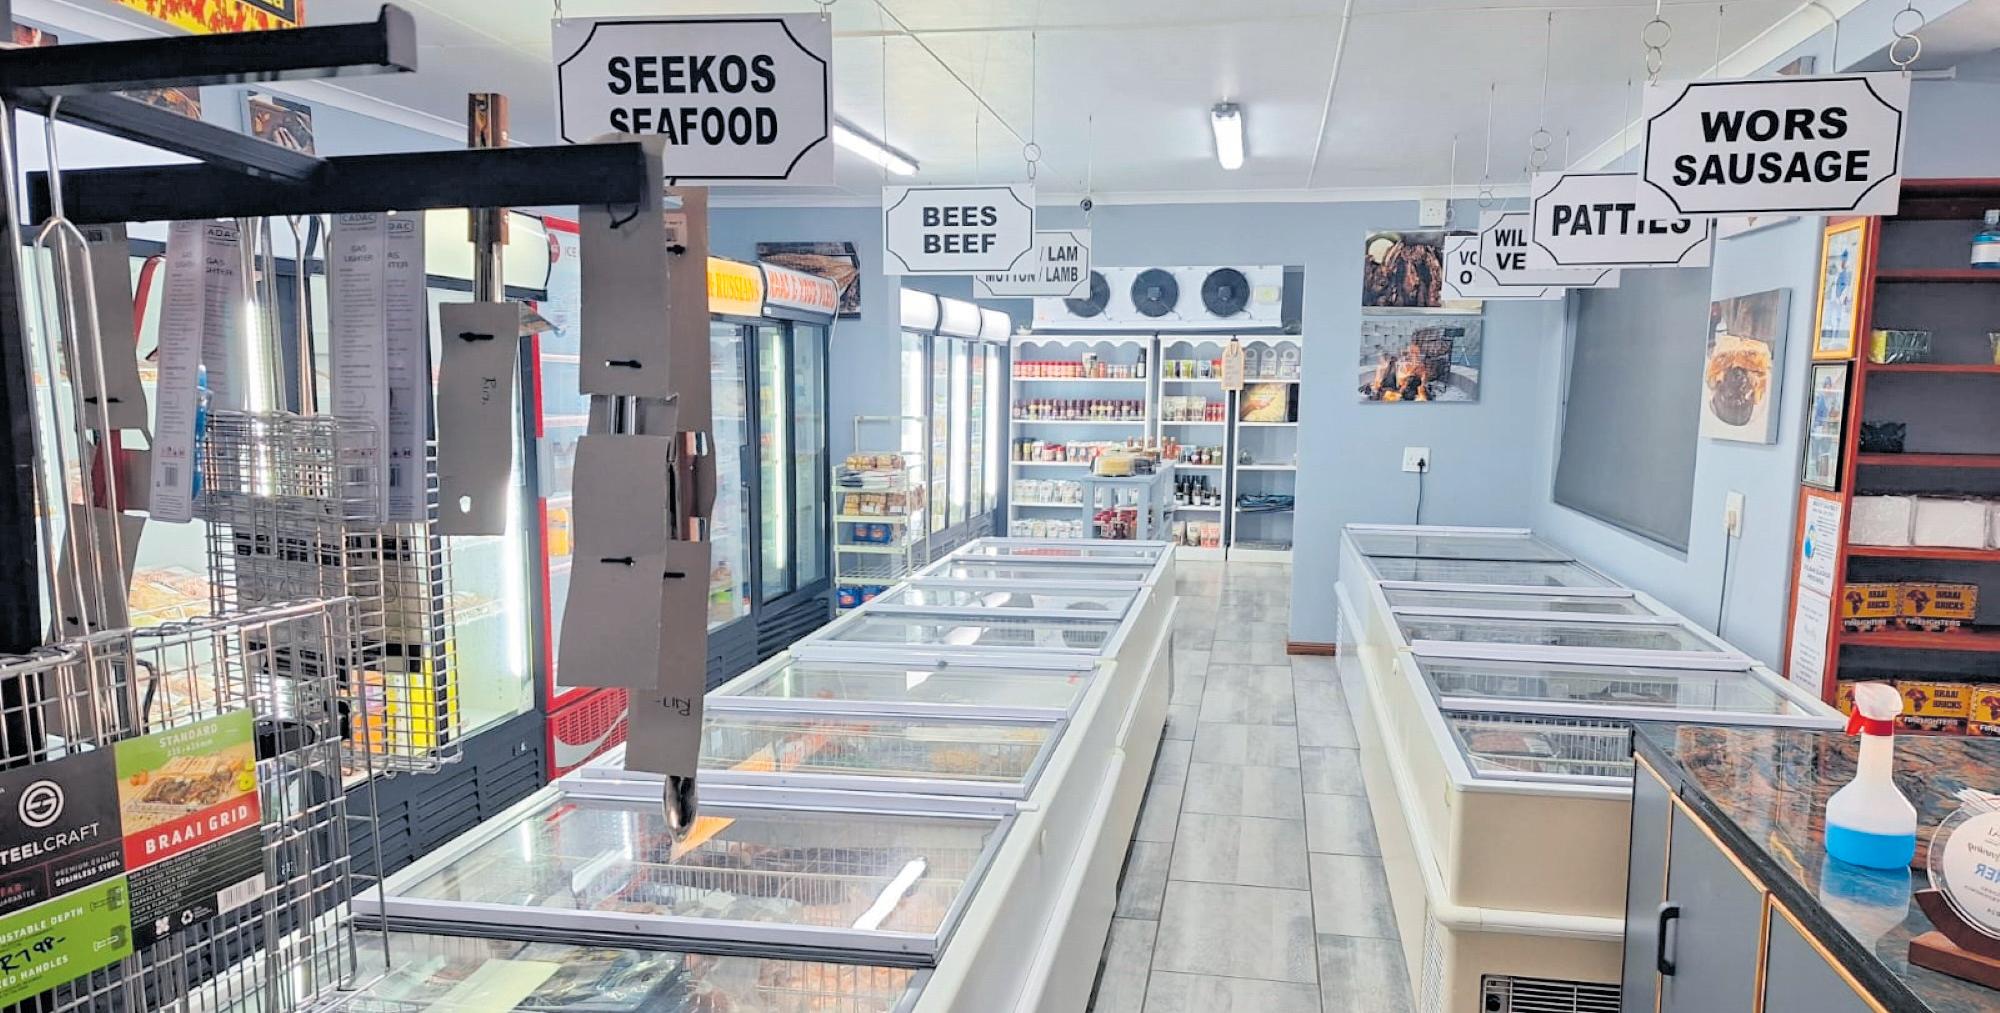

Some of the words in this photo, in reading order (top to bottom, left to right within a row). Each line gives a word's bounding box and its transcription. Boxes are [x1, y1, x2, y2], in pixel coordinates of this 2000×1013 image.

[607, 55, 776, 95] SEEKOS
[610, 107, 778, 145] SEAFOOD
[1700, 107, 1848, 143] WORS
[1673, 150, 1870, 187] SAUSAGE
[923, 206, 997, 227] BEES
[924, 233, 997, 253] BEEF
[1495, 229, 1527, 247] WIL
[1047, 246, 1078, 261] LAM
[1496, 253, 1526, 270] VE
[1045, 266, 1078, 282] LAMB
[1460, 270, 1473, 285] O
[160, 723, 217, 748] STANDARD
[145, 822, 202, 853] BRAAI
[208, 804, 249, 831] GRID
[0, 822, 100, 866] TEELCRAFT
[55, 867, 97, 887] STAINLESS
[97, 859, 120, 873] STEEL
[0, 920, 46, 944] USTABLE
[50, 906, 84, 926] DEPTH
[20, 954, 69, 980] HANDLES
